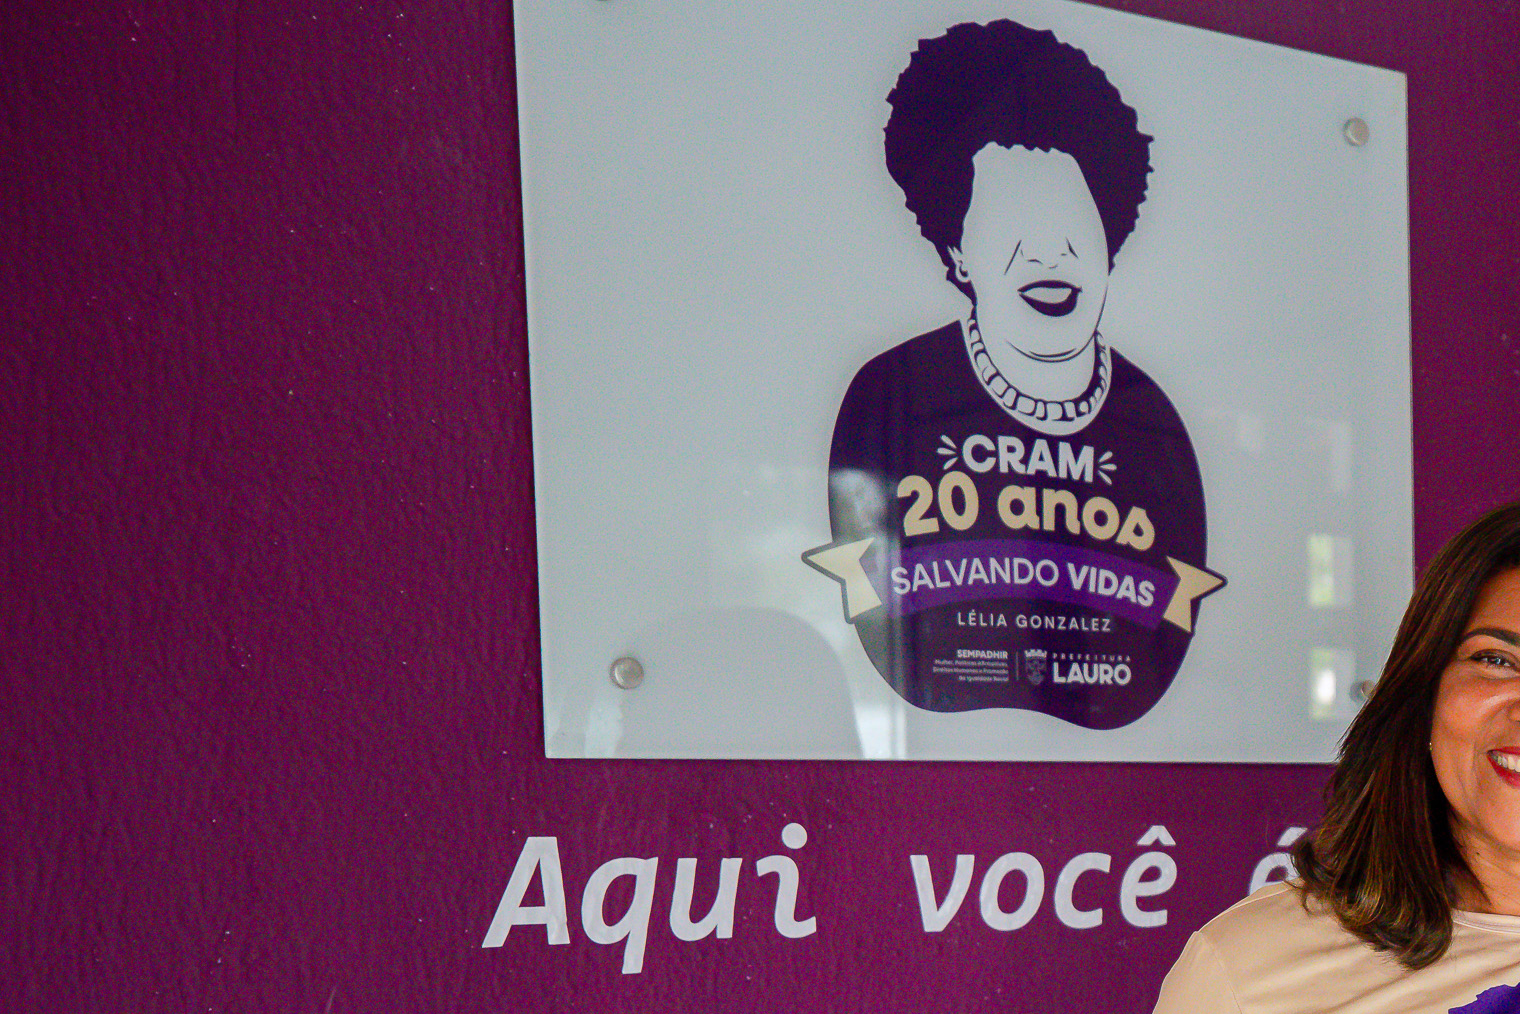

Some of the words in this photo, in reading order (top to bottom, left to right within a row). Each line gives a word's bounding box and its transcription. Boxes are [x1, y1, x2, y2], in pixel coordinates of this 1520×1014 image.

[962, 434, 1095, 483] CRAM
[897, 471, 979, 537] 20
[997, 485, 1155, 551] anos
[891, 557, 1059, 596] SALVANDO
[1067, 562, 1155, 607] VIDAS
[957, 609, 1008, 627] LÉLIA
[1016, 614, 1111, 632] GONZALEZ
[957, 649, 1008, 659] SEMPADHIR
[1053, 652, 1131, 662] PREFEITURA
[1053, 662, 1132, 685] LAURO
[482, 822, 817, 974] Aqui
[910, 825, 1177, 932] você
